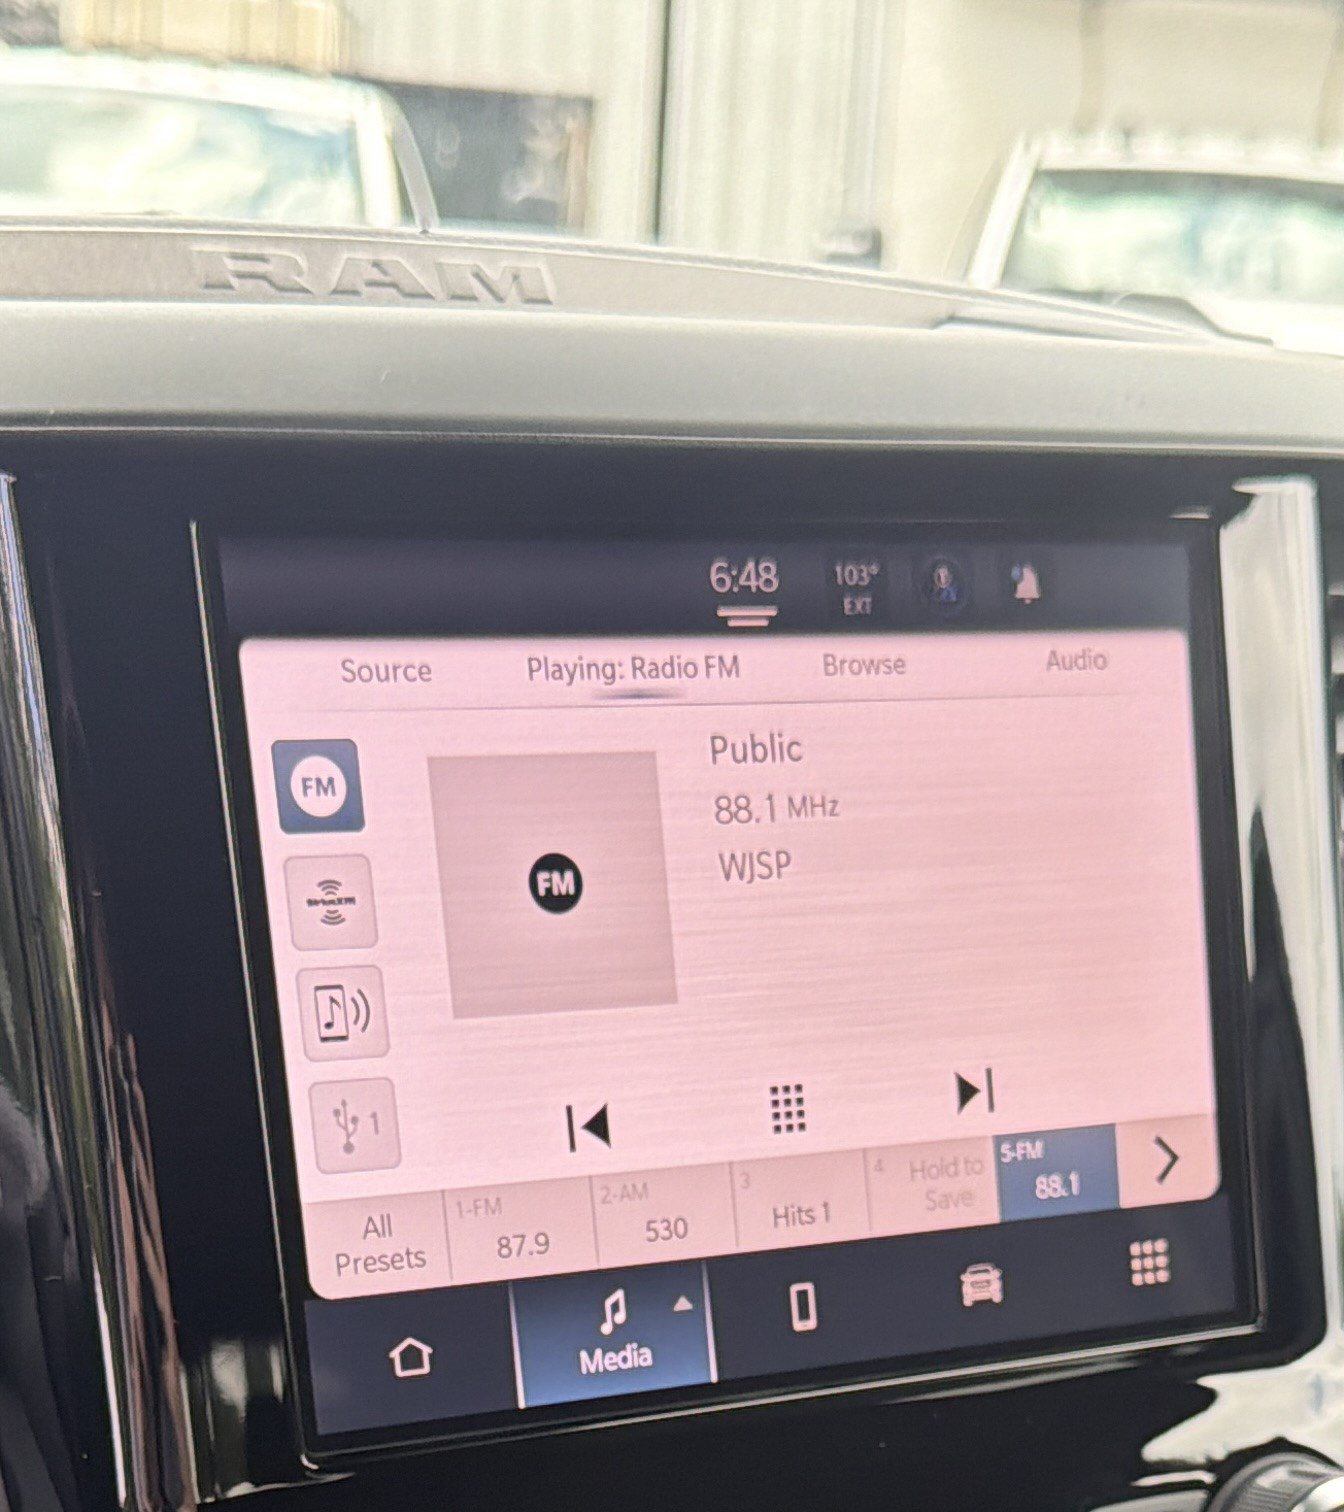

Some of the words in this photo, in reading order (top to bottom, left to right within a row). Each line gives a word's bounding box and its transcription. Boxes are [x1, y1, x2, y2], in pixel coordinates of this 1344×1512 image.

[192, 245, 555, 305] RAM
[709, 557, 780, 593] 6:48
[341, 659, 433, 684] Source
[527, 655, 625, 686] Playing:
[631, 655, 698, 682] Radio
[704, 654, 741, 679] FM
[823, 652, 907, 678] Browse
[1046, 647, 1109, 672] Audio
[710, 730, 803, 765] Public
[301, 775, 336, 799] FM
[714, 793, 776, 825] 88.1
[787, 795, 840, 819] MHz
[718, 850, 791, 884] WJSP
[535, 869, 575, 897] FM
[739, 1170, 751, 1190] 3
[909, 1157, 960, 1183] Hold
[962, 1156, 986, 1178] to
[599, 1182, 651, 1206] 2-AM
[924, 1185, 977, 1212] Save
[1033, 1171, 1081, 1201] 88.1
[454, 1197, 504, 1219] 1-FM
[772, 1202, 817, 1230] Hits
[821, 1200, 832, 1225] 1
[361, 1212, 394, 1241] All
[644, 1216, 690, 1244] 530
[496, 1231, 552, 1260] 87.9
[335, 1247, 427, 1279] Presets
[579, 1342, 654, 1376] Media
